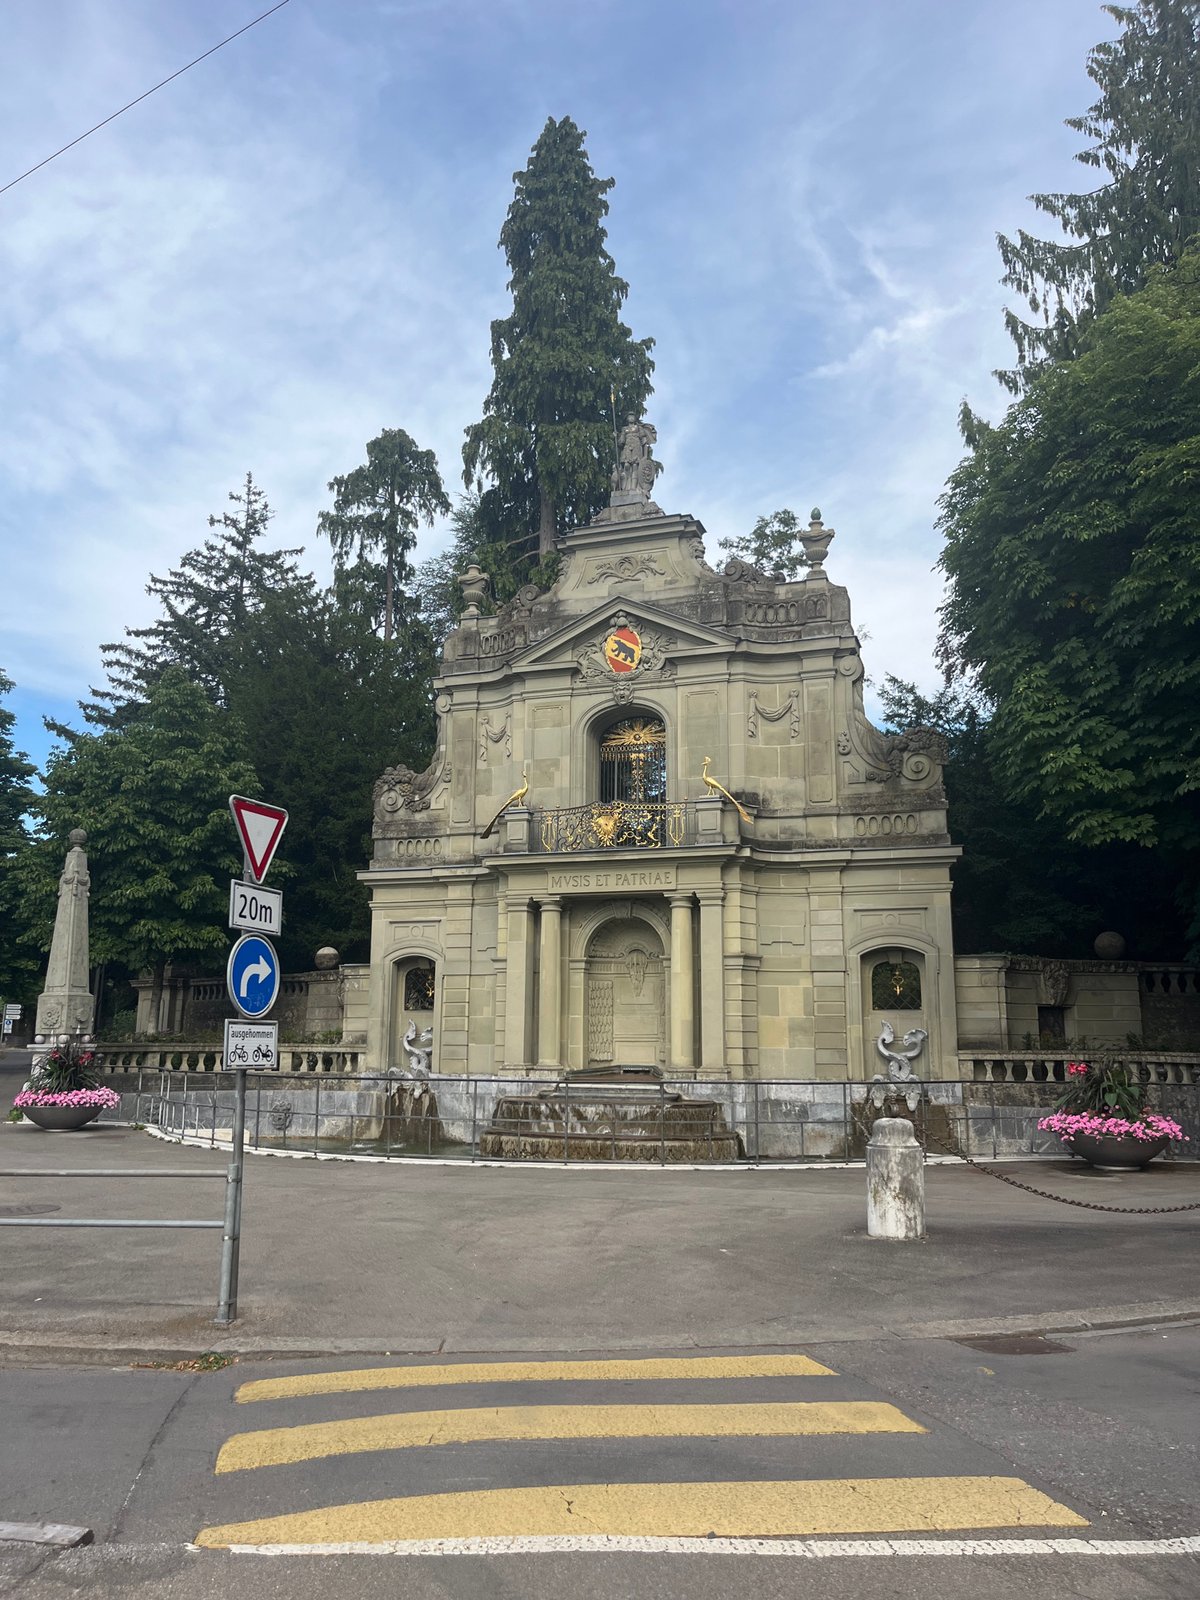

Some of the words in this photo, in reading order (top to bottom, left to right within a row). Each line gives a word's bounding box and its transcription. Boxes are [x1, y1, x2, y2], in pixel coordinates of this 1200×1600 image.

[551, 875, 591, 888] MVSIS
[595, 874, 611, 887] ET
[615, 872, 673, 886] PATRIAE
[239, 894, 272, 923] 20m
[231, 1029, 273, 1040] ausgenommen
